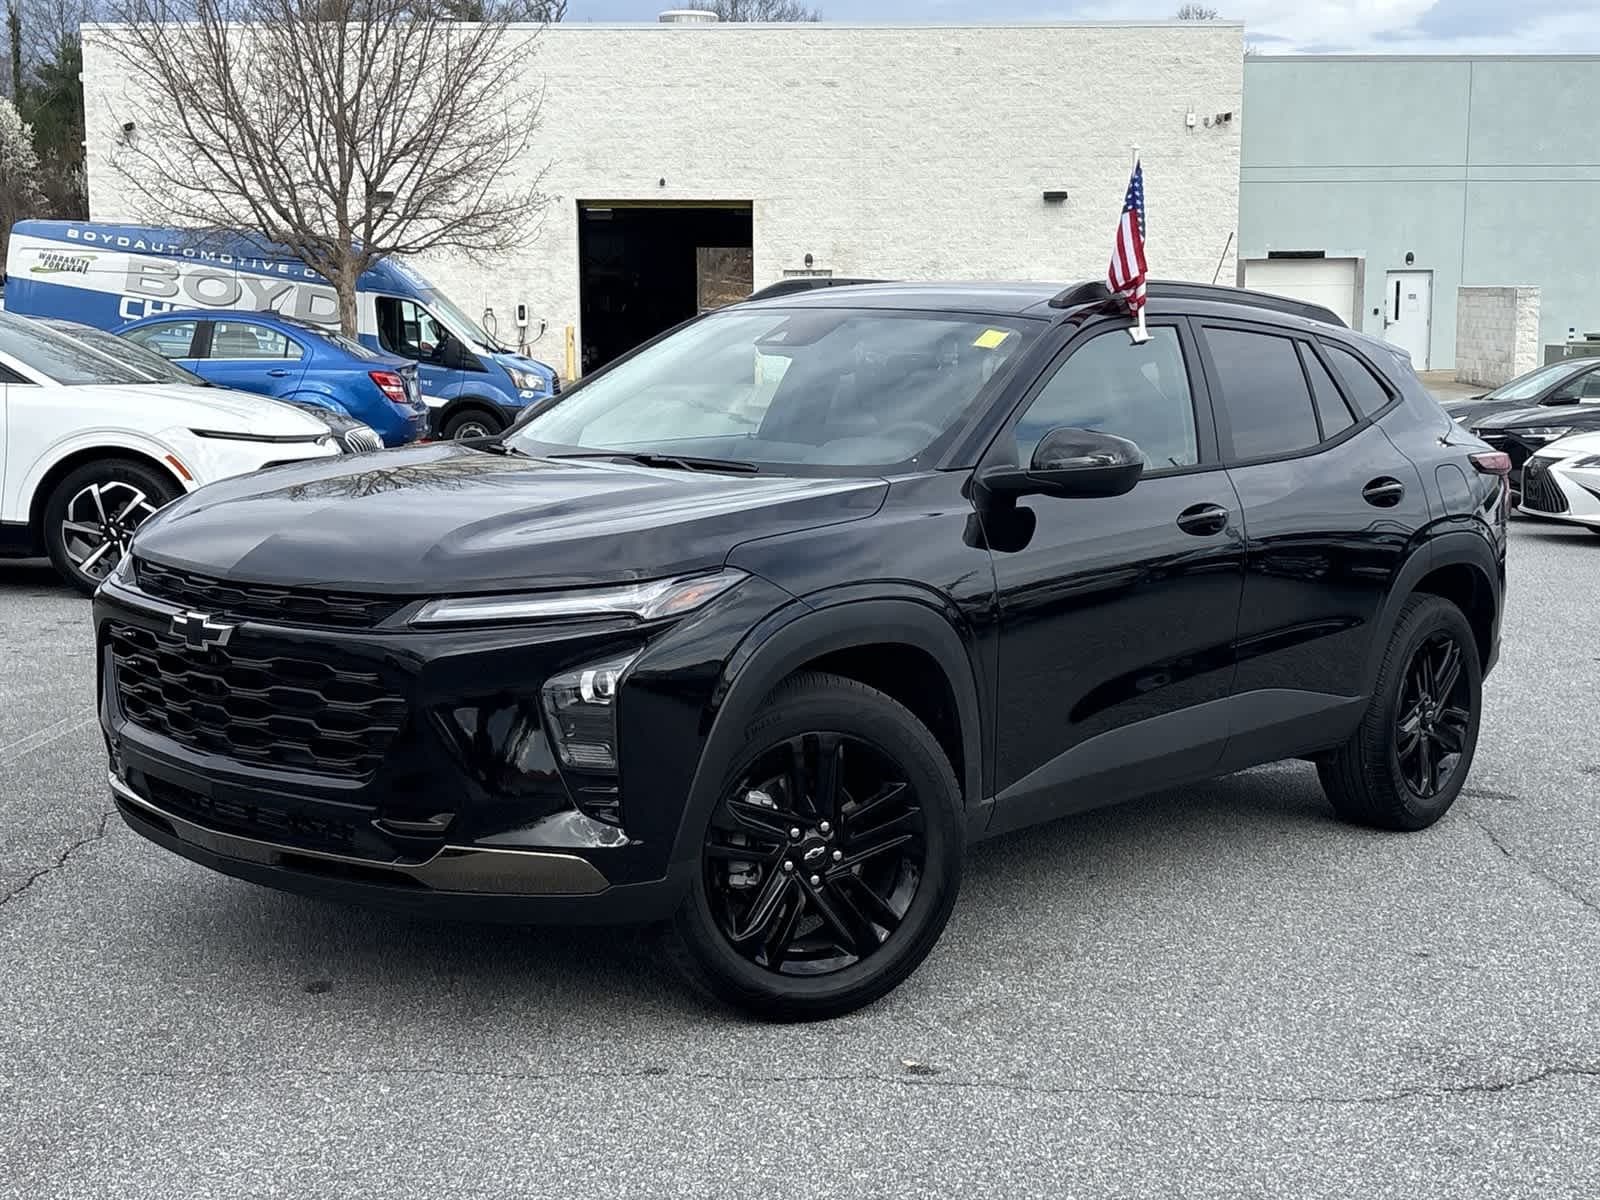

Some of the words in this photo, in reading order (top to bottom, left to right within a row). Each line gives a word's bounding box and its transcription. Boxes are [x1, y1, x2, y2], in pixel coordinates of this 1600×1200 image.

[39, 252, 87, 265] WARRANTY
[67, 228, 328, 279] BOYDAUTOMOTIVE.C
[126, 257, 341, 324] BOYD
